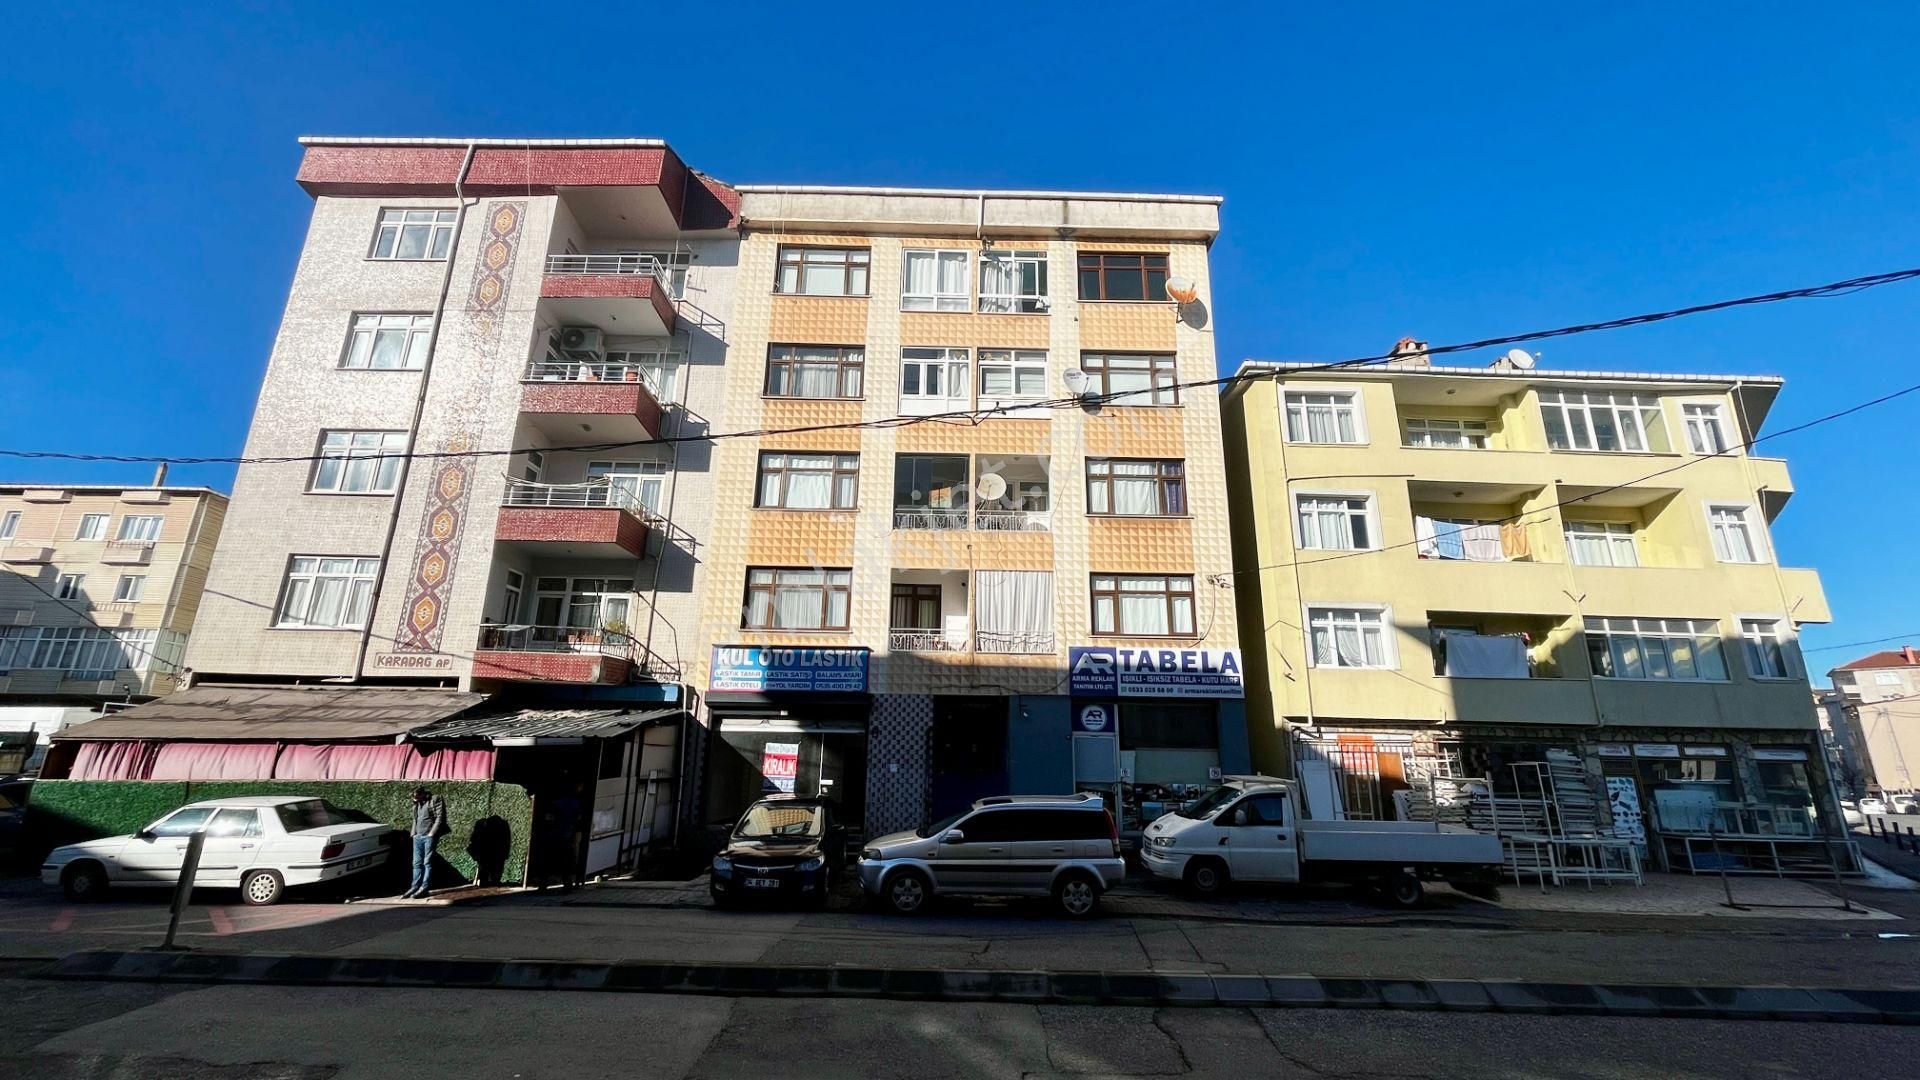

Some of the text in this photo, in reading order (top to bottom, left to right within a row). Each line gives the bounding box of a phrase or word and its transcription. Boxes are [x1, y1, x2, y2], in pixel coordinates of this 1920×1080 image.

[435, 658, 450, 668] AP
[718, 649, 753, 667] KUL
[758, 649, 795, 667] OTO
[1072, 652, 1115, 674] AR
[1119, 650, 1240, 674] TABELA
